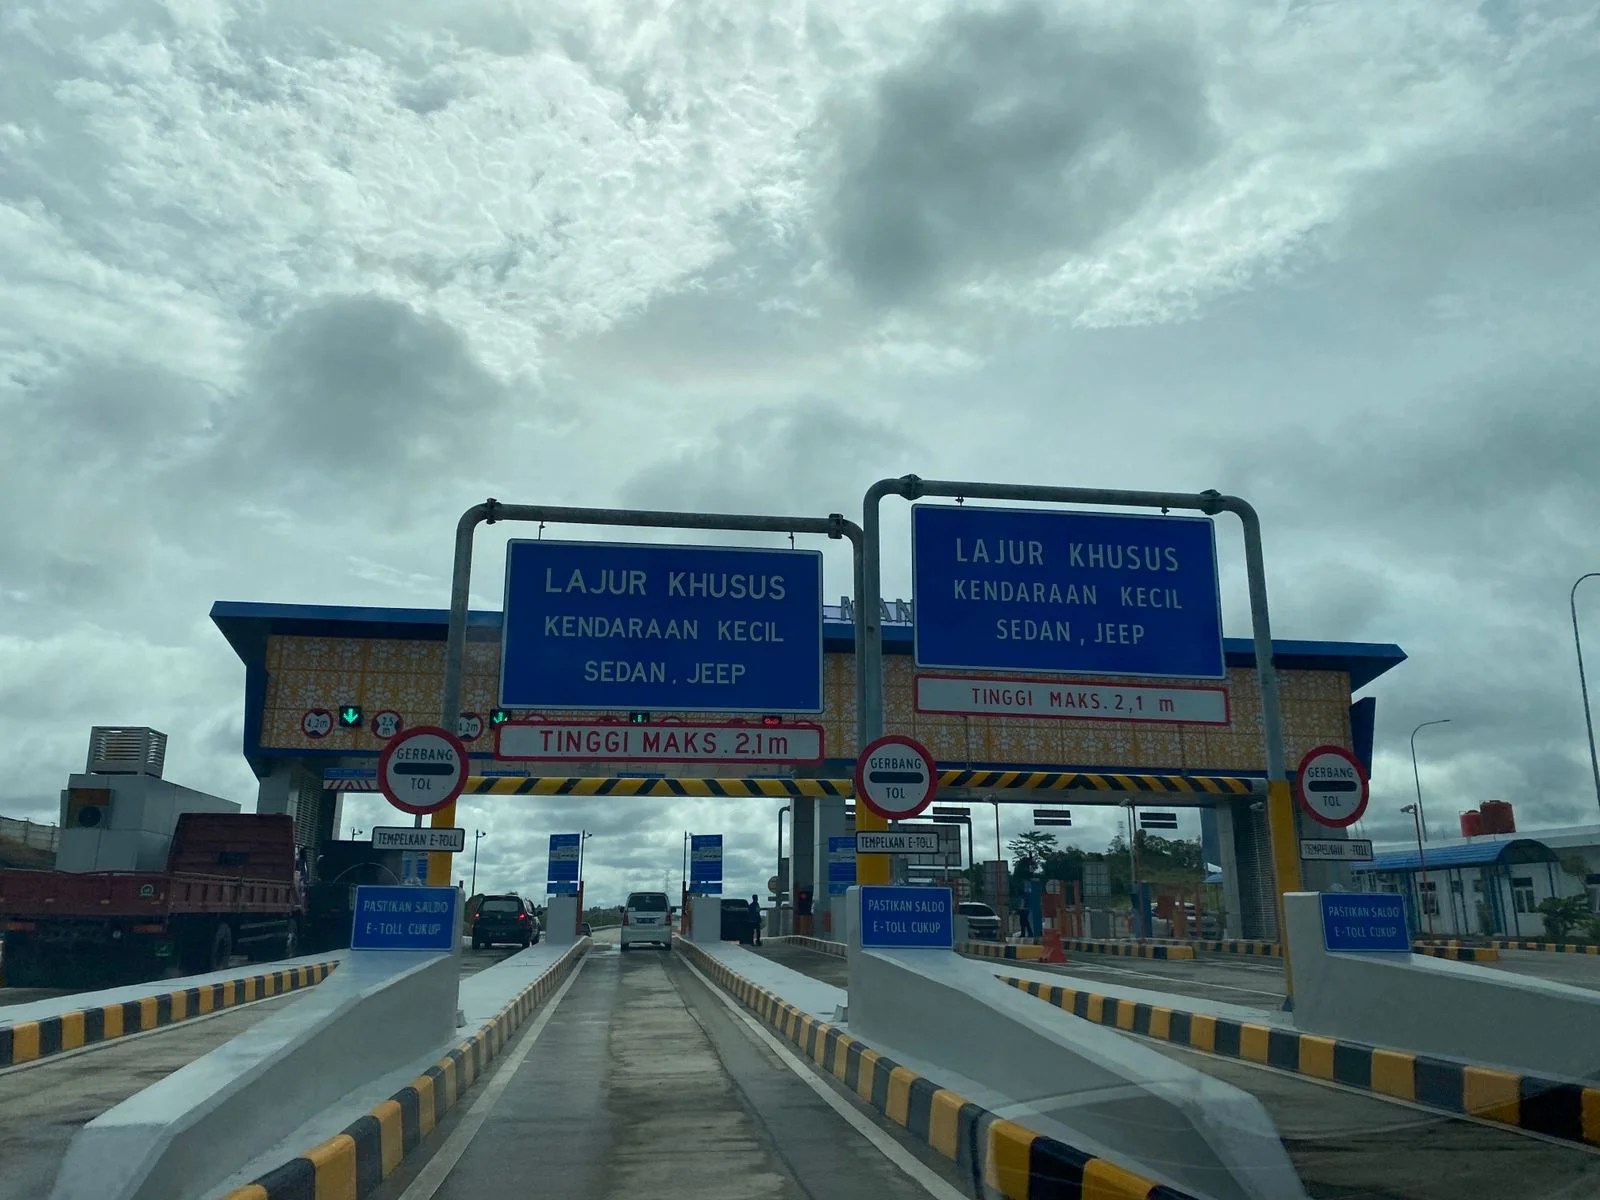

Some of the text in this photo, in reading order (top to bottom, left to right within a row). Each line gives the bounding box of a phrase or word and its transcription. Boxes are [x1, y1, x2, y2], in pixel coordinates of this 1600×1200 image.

[956, 538, 1179, 572] LAJUR KHUSUS
[545, 568, 786, 600] LAJUR KHUSUS
[953, 579, 1183, 610] KENDARAAN KECIL
[544, 616, 785, 643] KENDARAAN KECIL
[1094, 622, 1146, 645] JEEP
[686, 663, 747, 684] JEEP
[971, 688, 1033, 707] TINGGI
[540, 730, 630, 753] TINGGI
[396, 748, 454, 761] GERBANG
[870, 757, 922, 770] GERBANG
[1307, 767, 1354, 779] GERBANG
[410, 777, 432, 791] TOL
[886, 787, 905, 800] TOL
[1322, 795, 1342, 808] TOL
[377, 832, 459, 848] TEMPELKAN E-TOLL
[860, 836, 934, 849] TEMPELKAN E-TOLL
[363, 900, 449, 914] PASTIKAN SALDO
[868, 899, 945, 914] PASTIKAN SALDO
[1328, 906, 1370, 919] PASTIKAN
[408, 922, 441, 936] CUKUP
[911, 921, 941, 934] CUKUP
[1369, 926, 1397, 938] CUKUP
